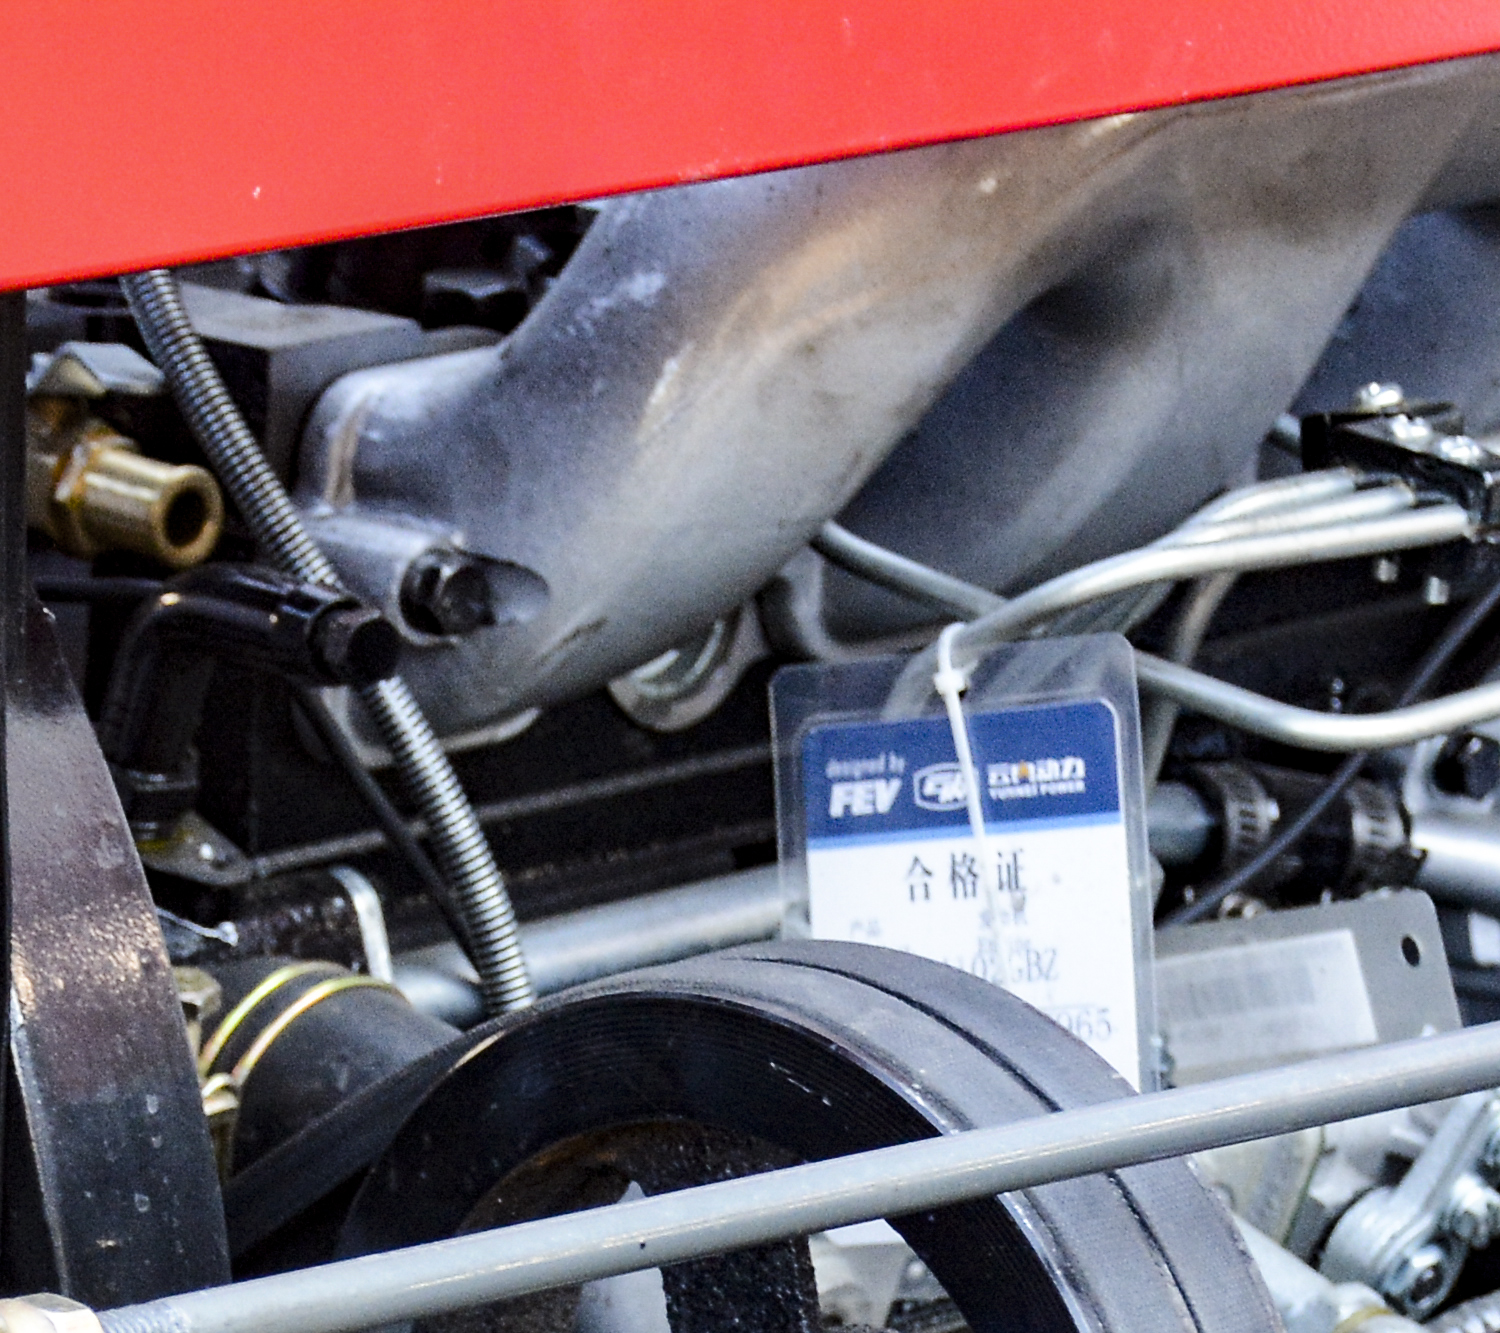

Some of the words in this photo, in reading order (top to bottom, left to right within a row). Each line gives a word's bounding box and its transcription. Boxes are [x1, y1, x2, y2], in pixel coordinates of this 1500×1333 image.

[829, 778, 903, 818] FEV
[906, 849, 1027, 902] 合格证
